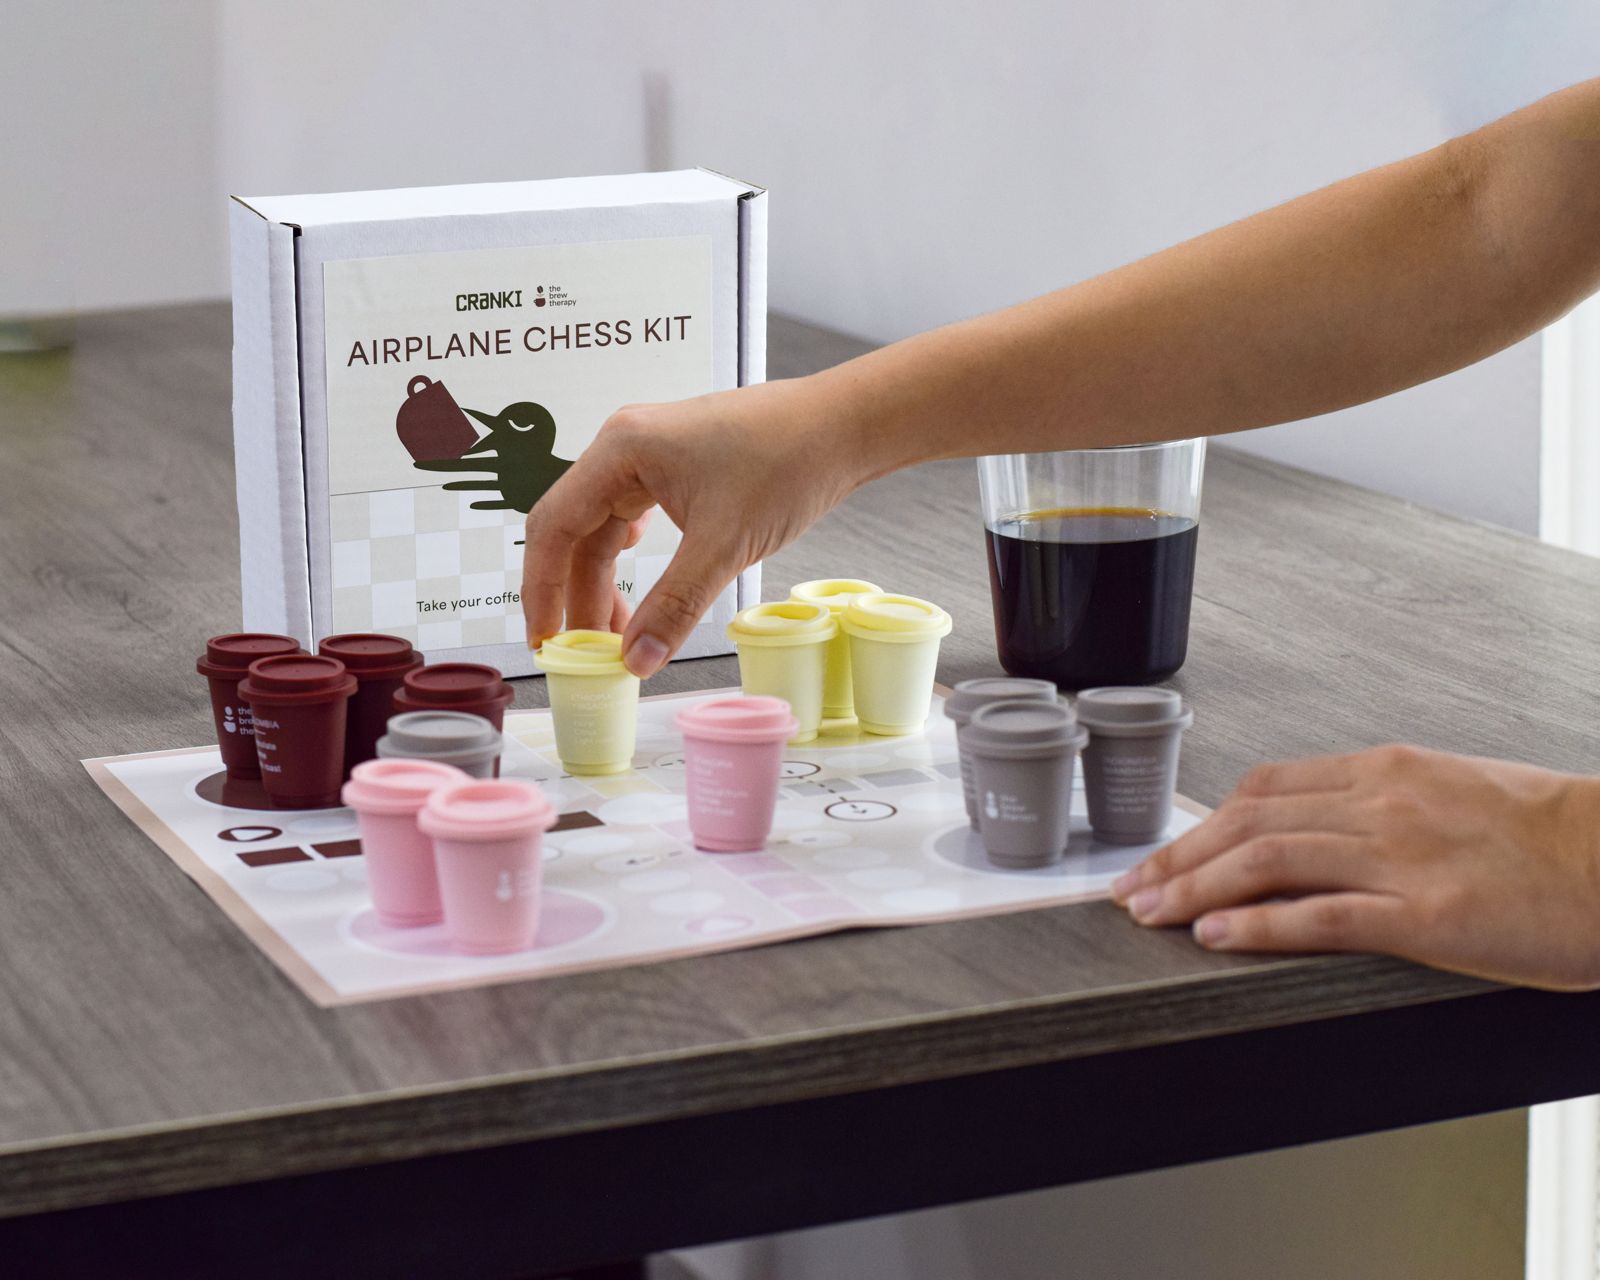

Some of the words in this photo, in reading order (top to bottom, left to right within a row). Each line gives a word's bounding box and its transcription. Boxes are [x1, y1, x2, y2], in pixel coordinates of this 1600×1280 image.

[549, 299, 577, 307] therapy
[347, 329, 512, 367] AIRPLANE
[523, 320, 632, 352] CHESS
[644, 315, 692, 343] KIT
[416, 601, 447, 613] Take
[450, 596, 482, 612] your
[485, 592, 520, 606] coffe
